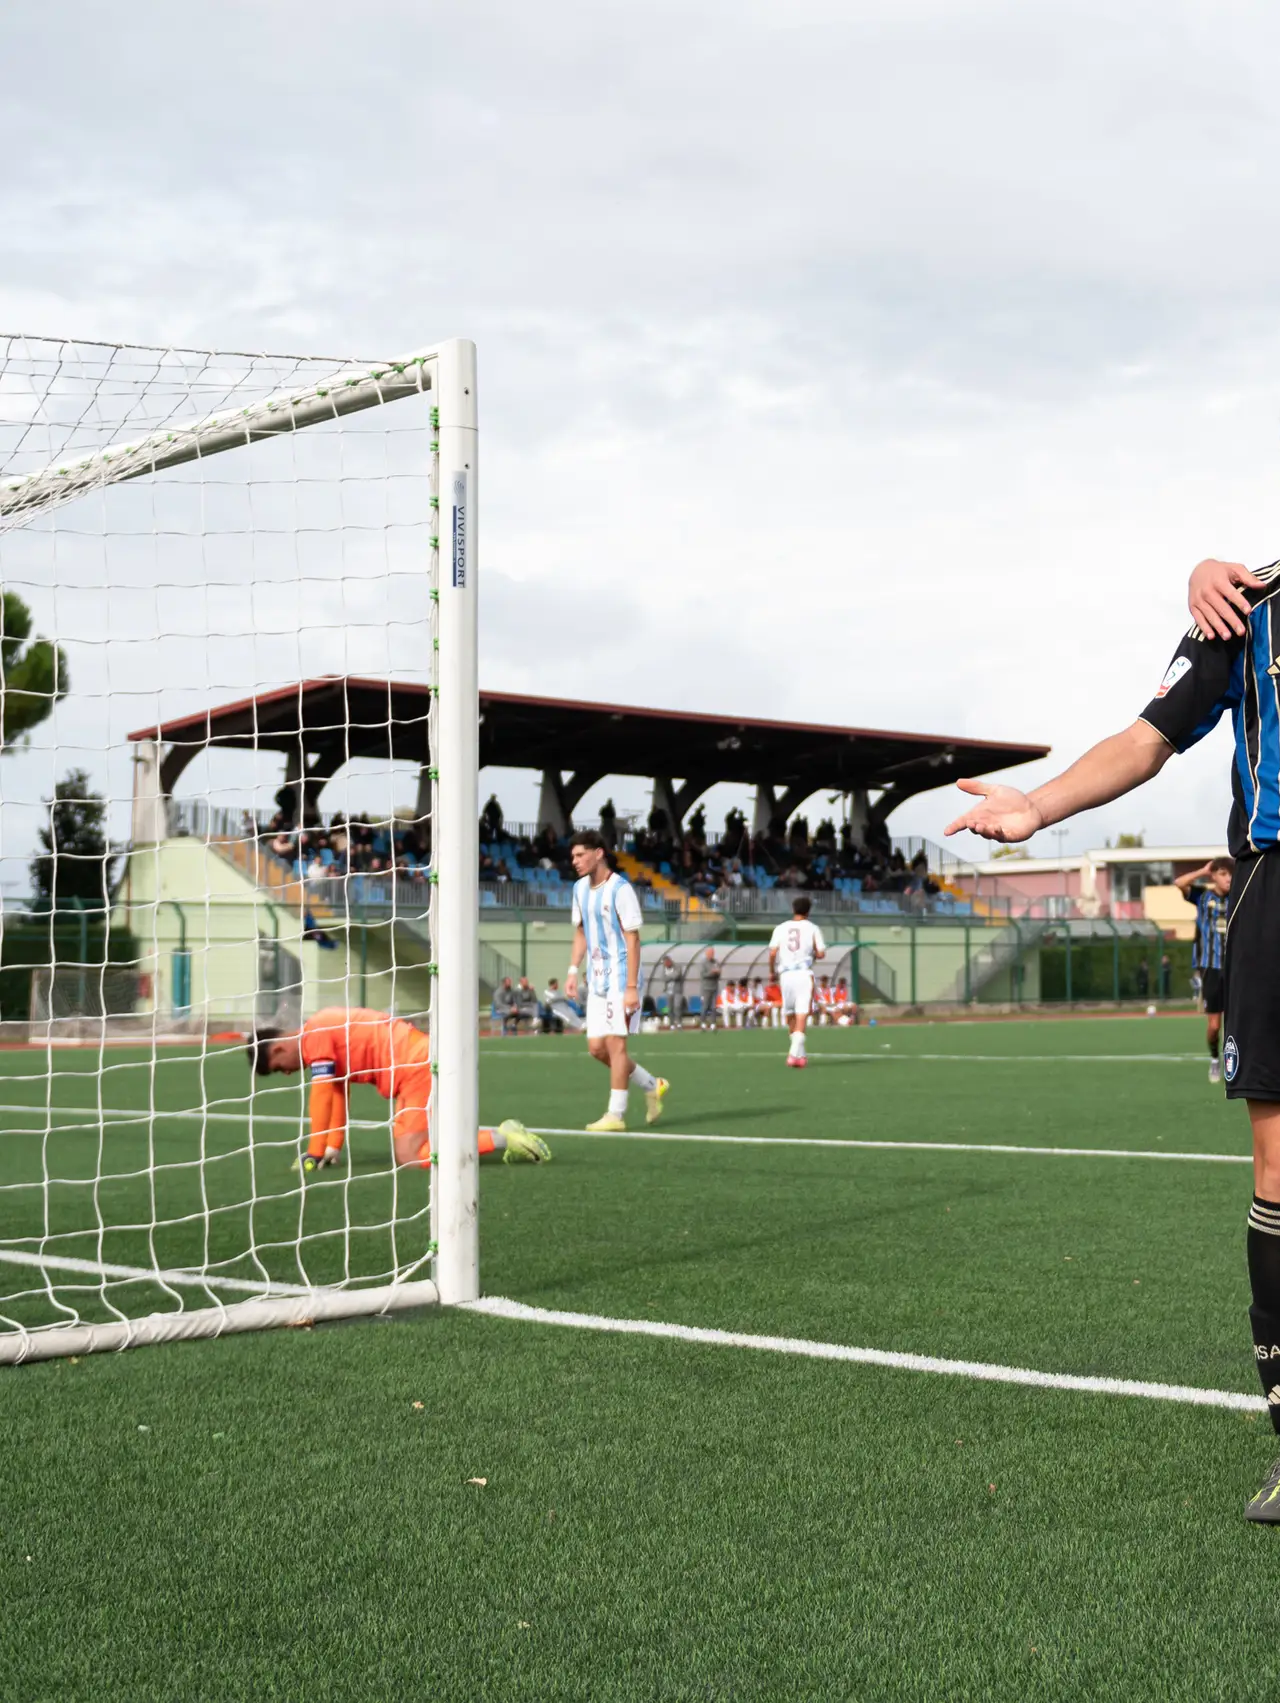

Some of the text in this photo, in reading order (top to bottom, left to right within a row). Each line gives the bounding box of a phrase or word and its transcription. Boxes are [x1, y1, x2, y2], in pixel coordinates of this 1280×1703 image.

[457, 506, 466, 588] VIVISPORT
[787, 927, 801, 953] 3
[606, 1001, 614, 1019] 5
